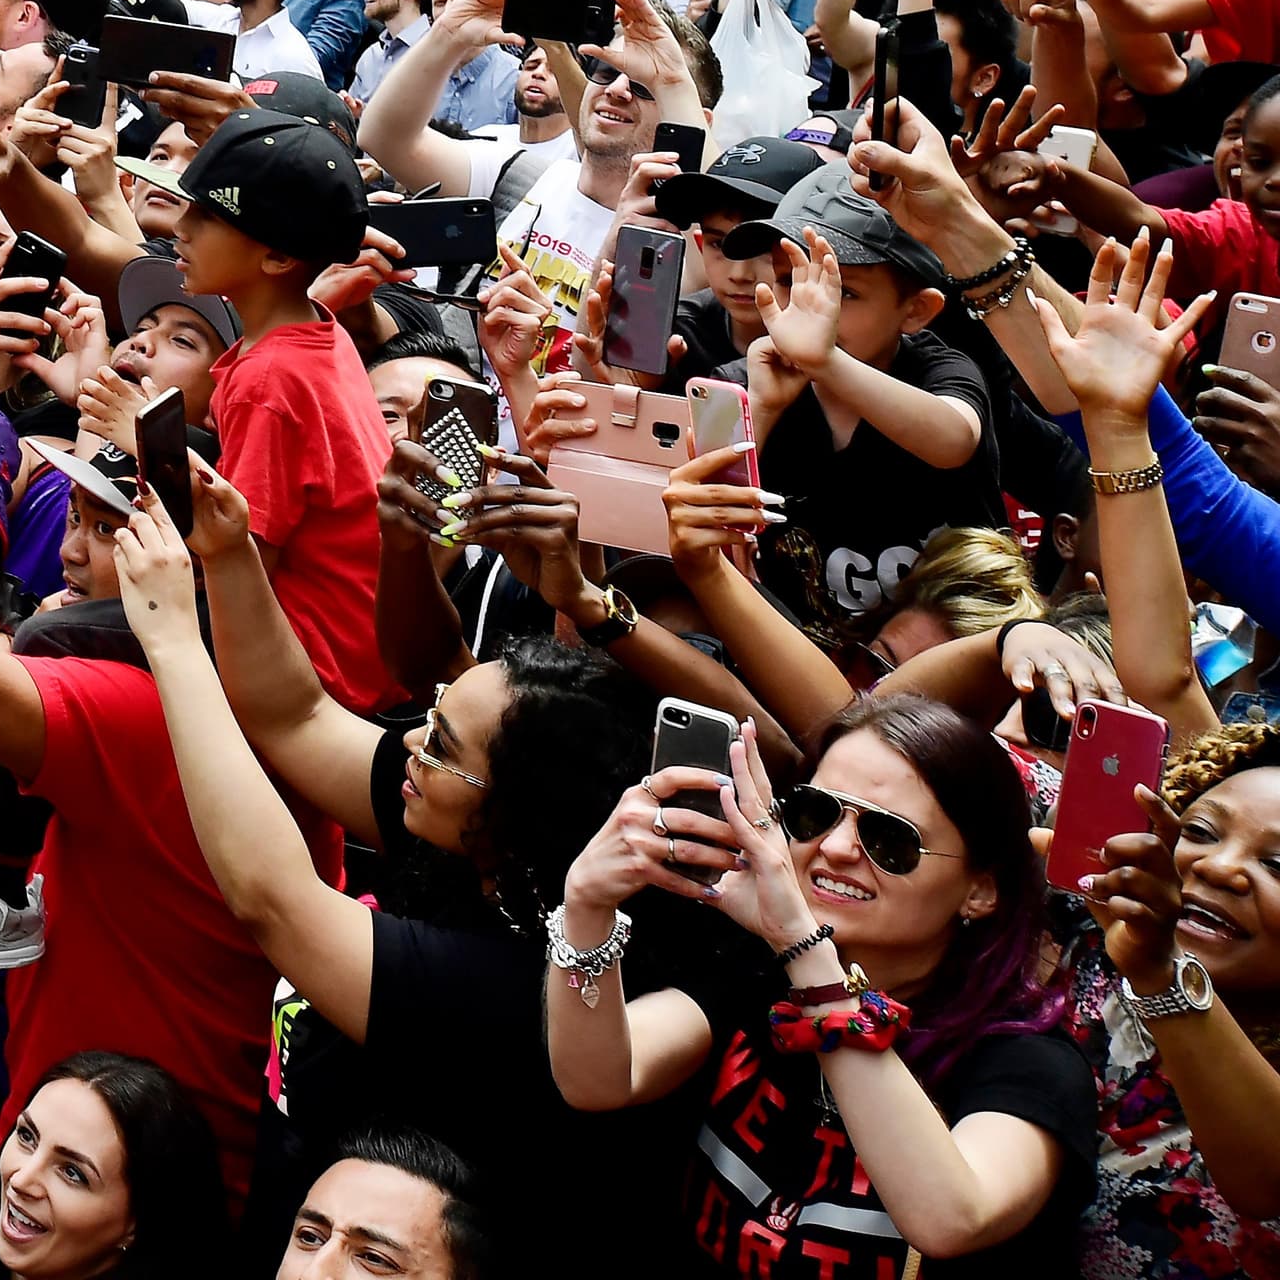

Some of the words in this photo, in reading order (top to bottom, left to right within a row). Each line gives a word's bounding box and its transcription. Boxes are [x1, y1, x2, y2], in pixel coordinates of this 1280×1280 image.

[208, 191, 241, 216] adidas
[521, 231, 573, 257] 2019
[710, 1029, 786, 1154] WE
